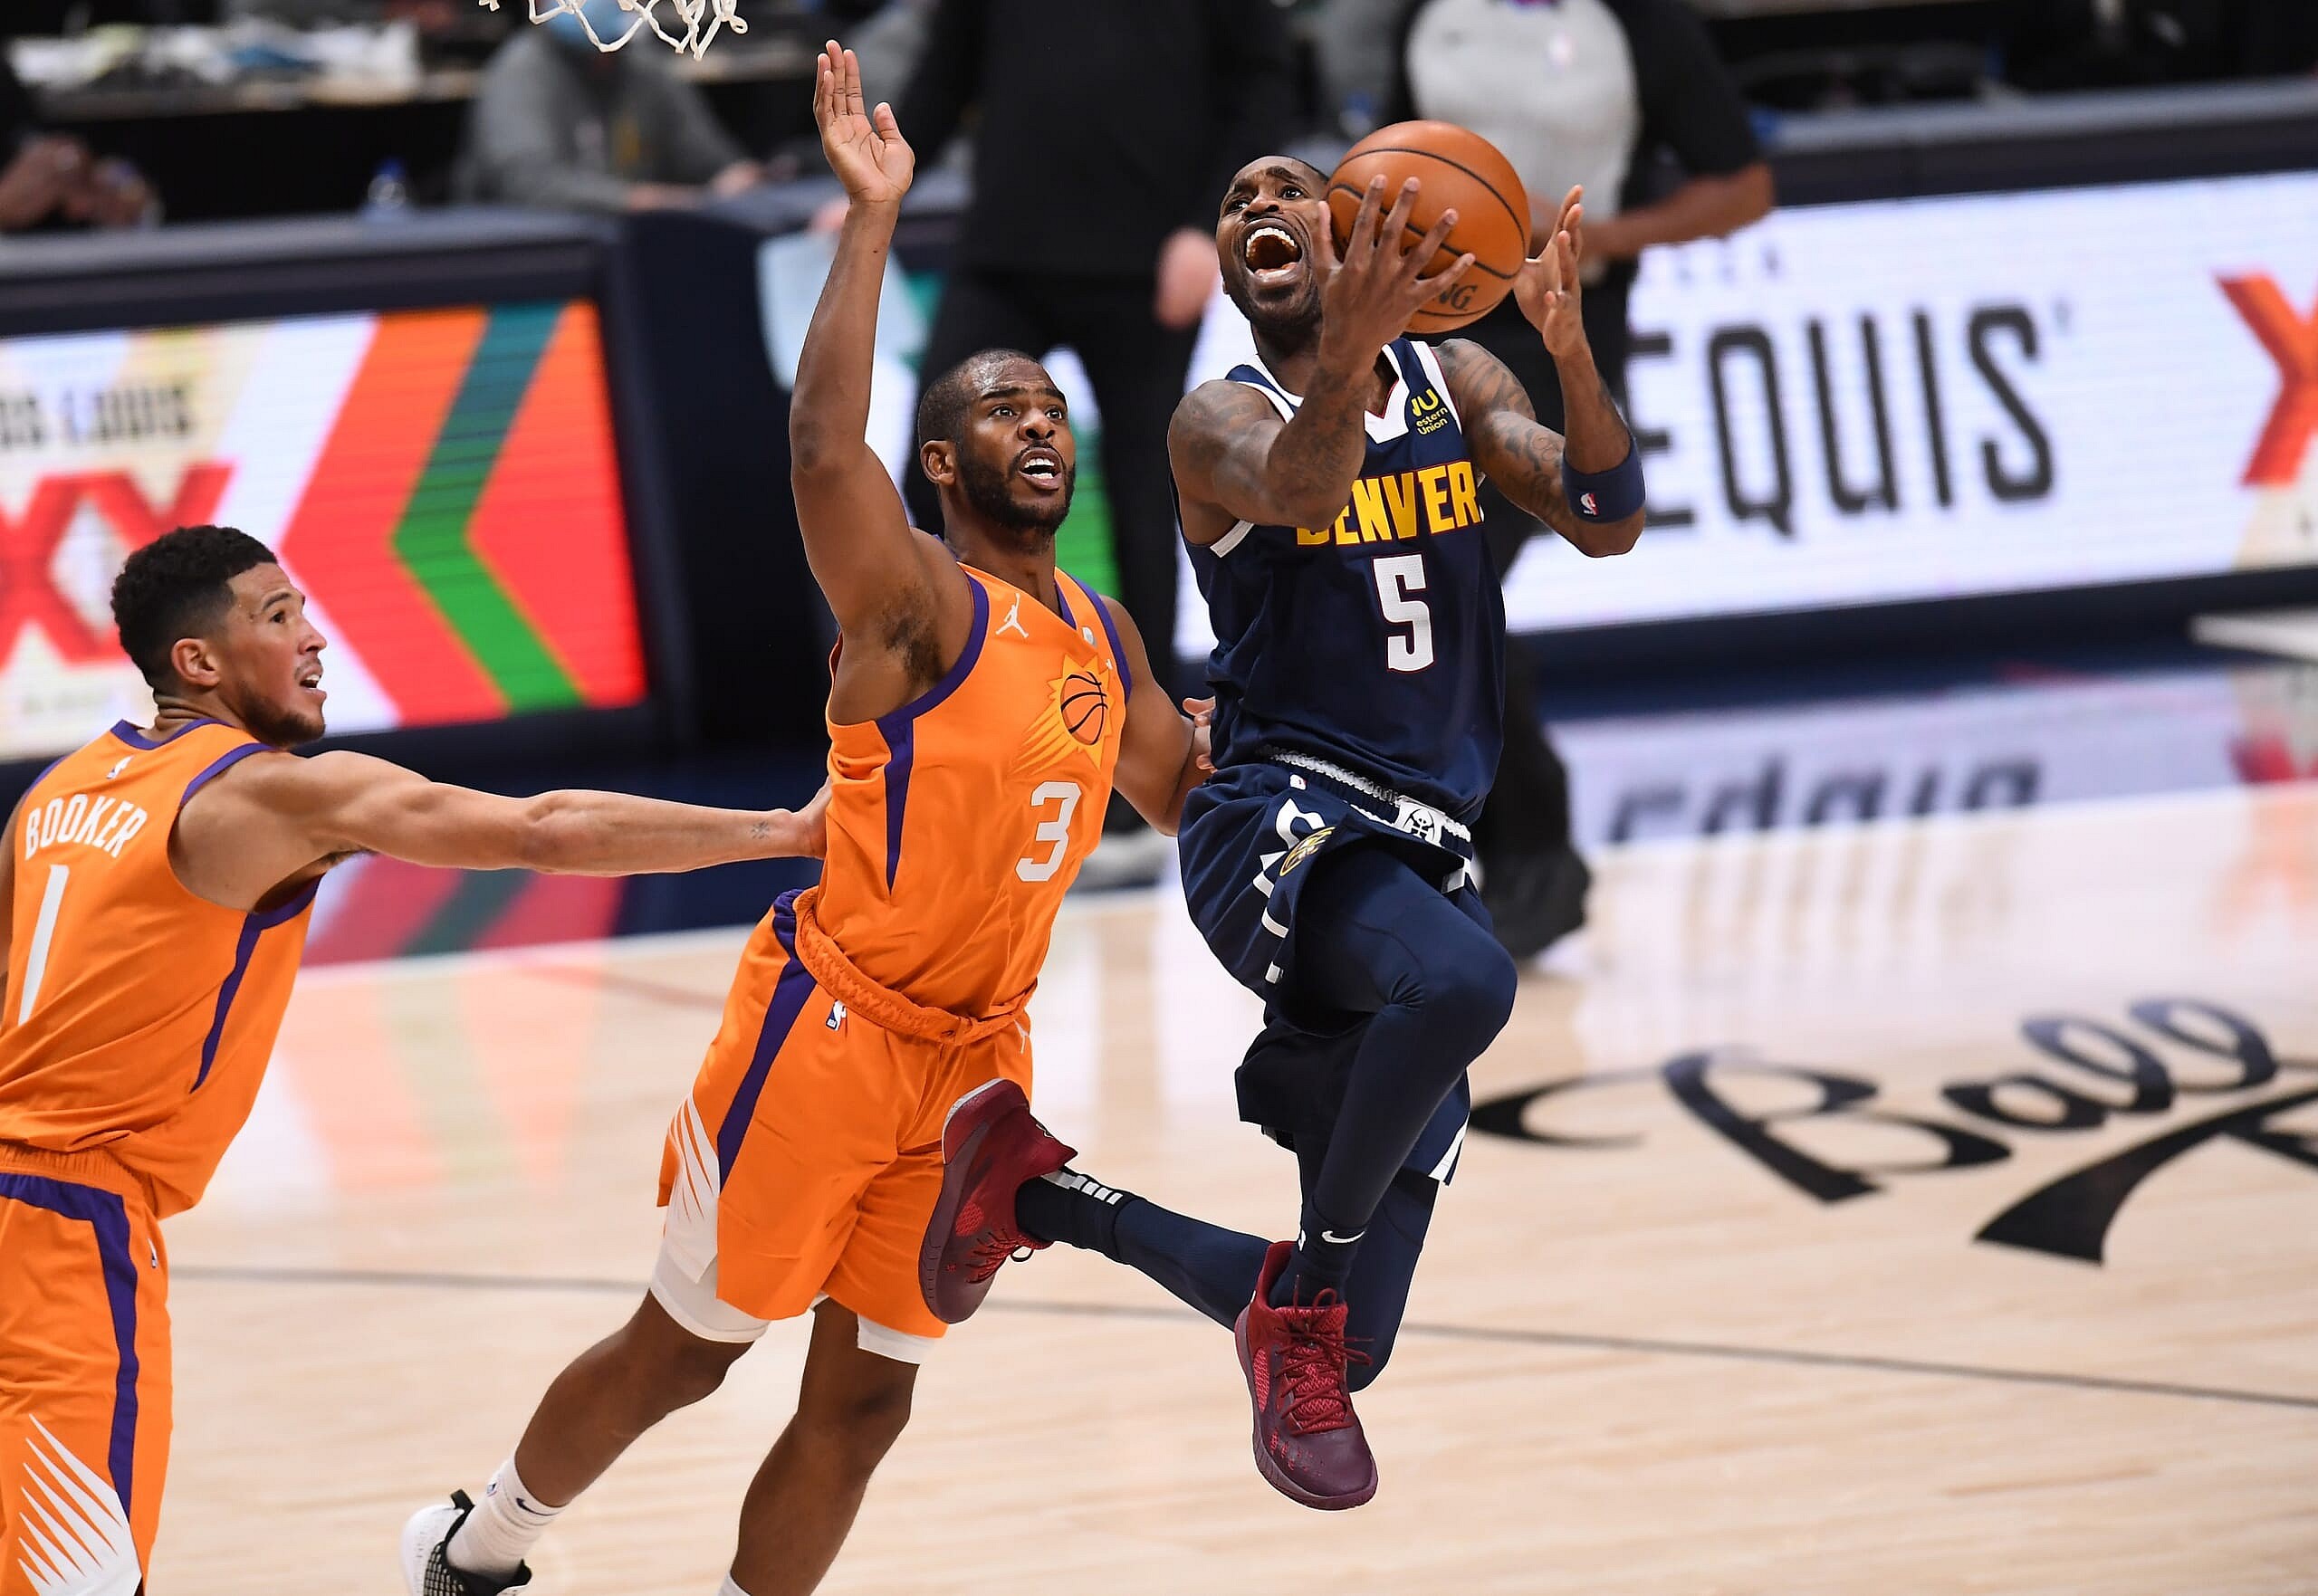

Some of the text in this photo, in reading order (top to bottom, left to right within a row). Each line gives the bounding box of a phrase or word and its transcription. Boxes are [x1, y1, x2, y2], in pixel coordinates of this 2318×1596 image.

[1415, 406, 1449, 427] estern
[1417, 417, 1449, 435] Union
[1297, 459, 1482, 547] ENVER
[1373, 552, 1434, 673] 5
[24, 793, 148, 861] BOOKER
[1015, 780, 1082, 882] 3
[17, 864, 70, 1027] 1
[1469, 996, 2282, 1206] Ball
